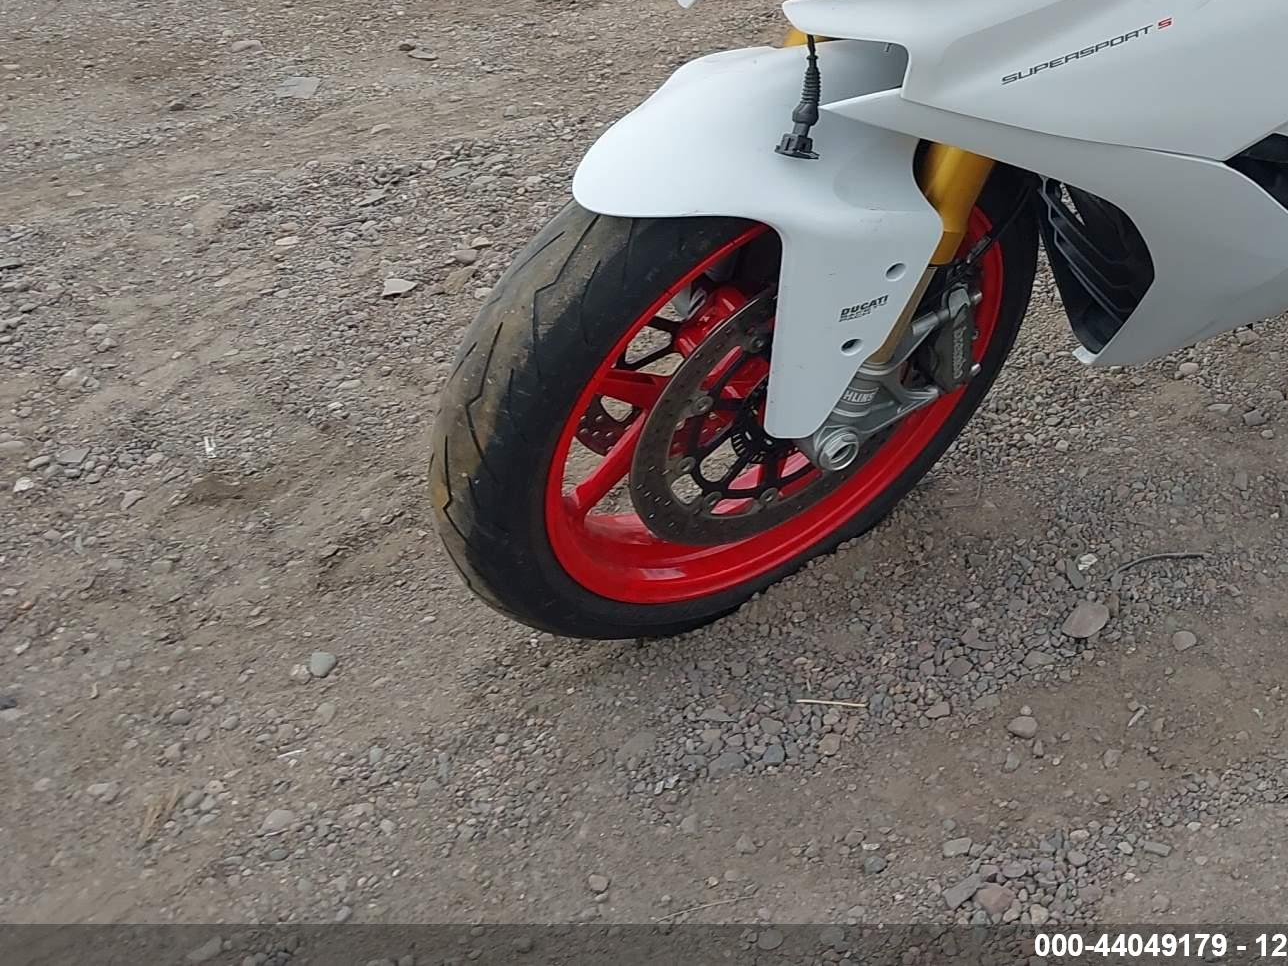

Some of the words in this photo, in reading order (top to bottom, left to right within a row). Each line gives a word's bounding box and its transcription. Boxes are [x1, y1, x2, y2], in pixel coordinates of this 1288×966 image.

[1001, 24, 1154, 85] SUPERSPORT
[1157, 18, 1173, 31] S
[840, 294, 889, 317] DUCATI
[842, 389, 878, 403] HLINS
